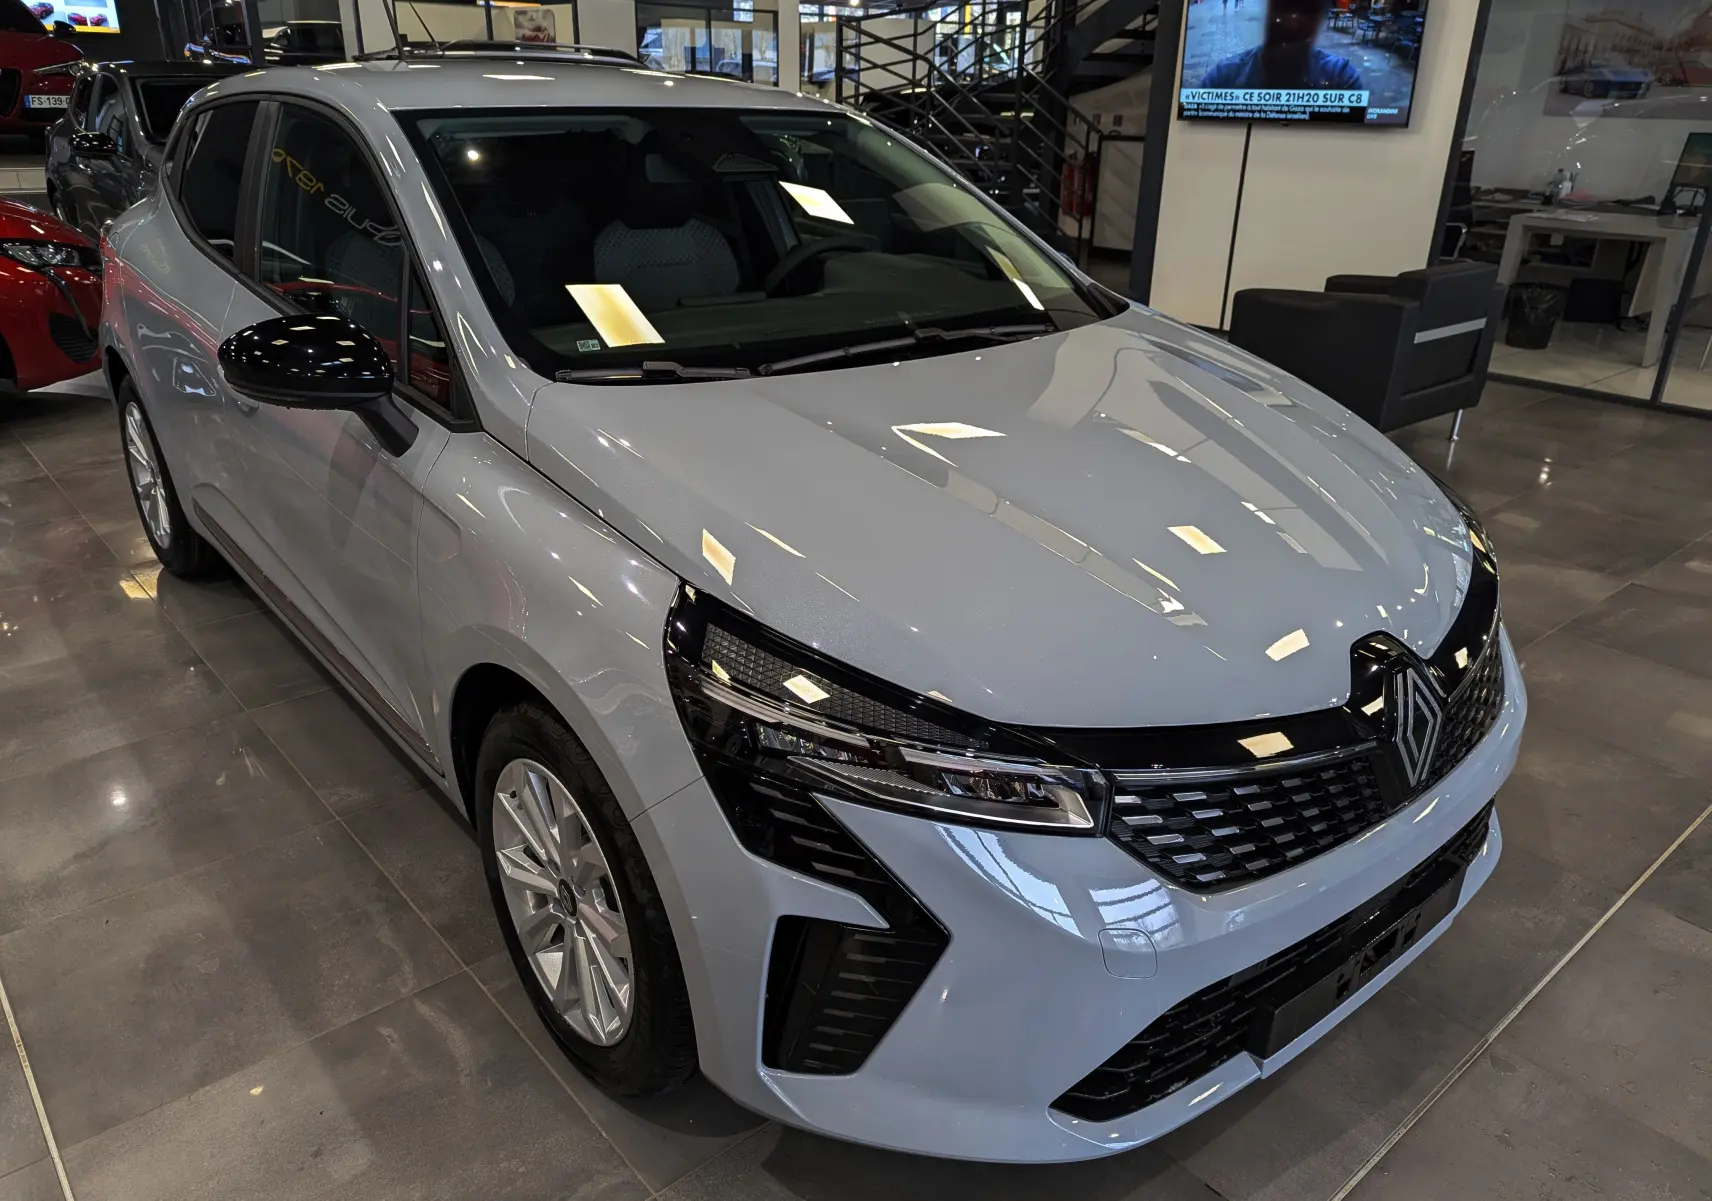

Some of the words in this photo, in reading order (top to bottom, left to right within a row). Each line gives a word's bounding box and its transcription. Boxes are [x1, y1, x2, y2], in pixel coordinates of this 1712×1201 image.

[1243, 92, 1254, 102] CE
[1257, 92, 1282, 102] SOIR
[1285, 92, 1320, 103] 21H20
[1322, 93, 1344, 104] SUR
[1348, 93, 1363, 104] C8
